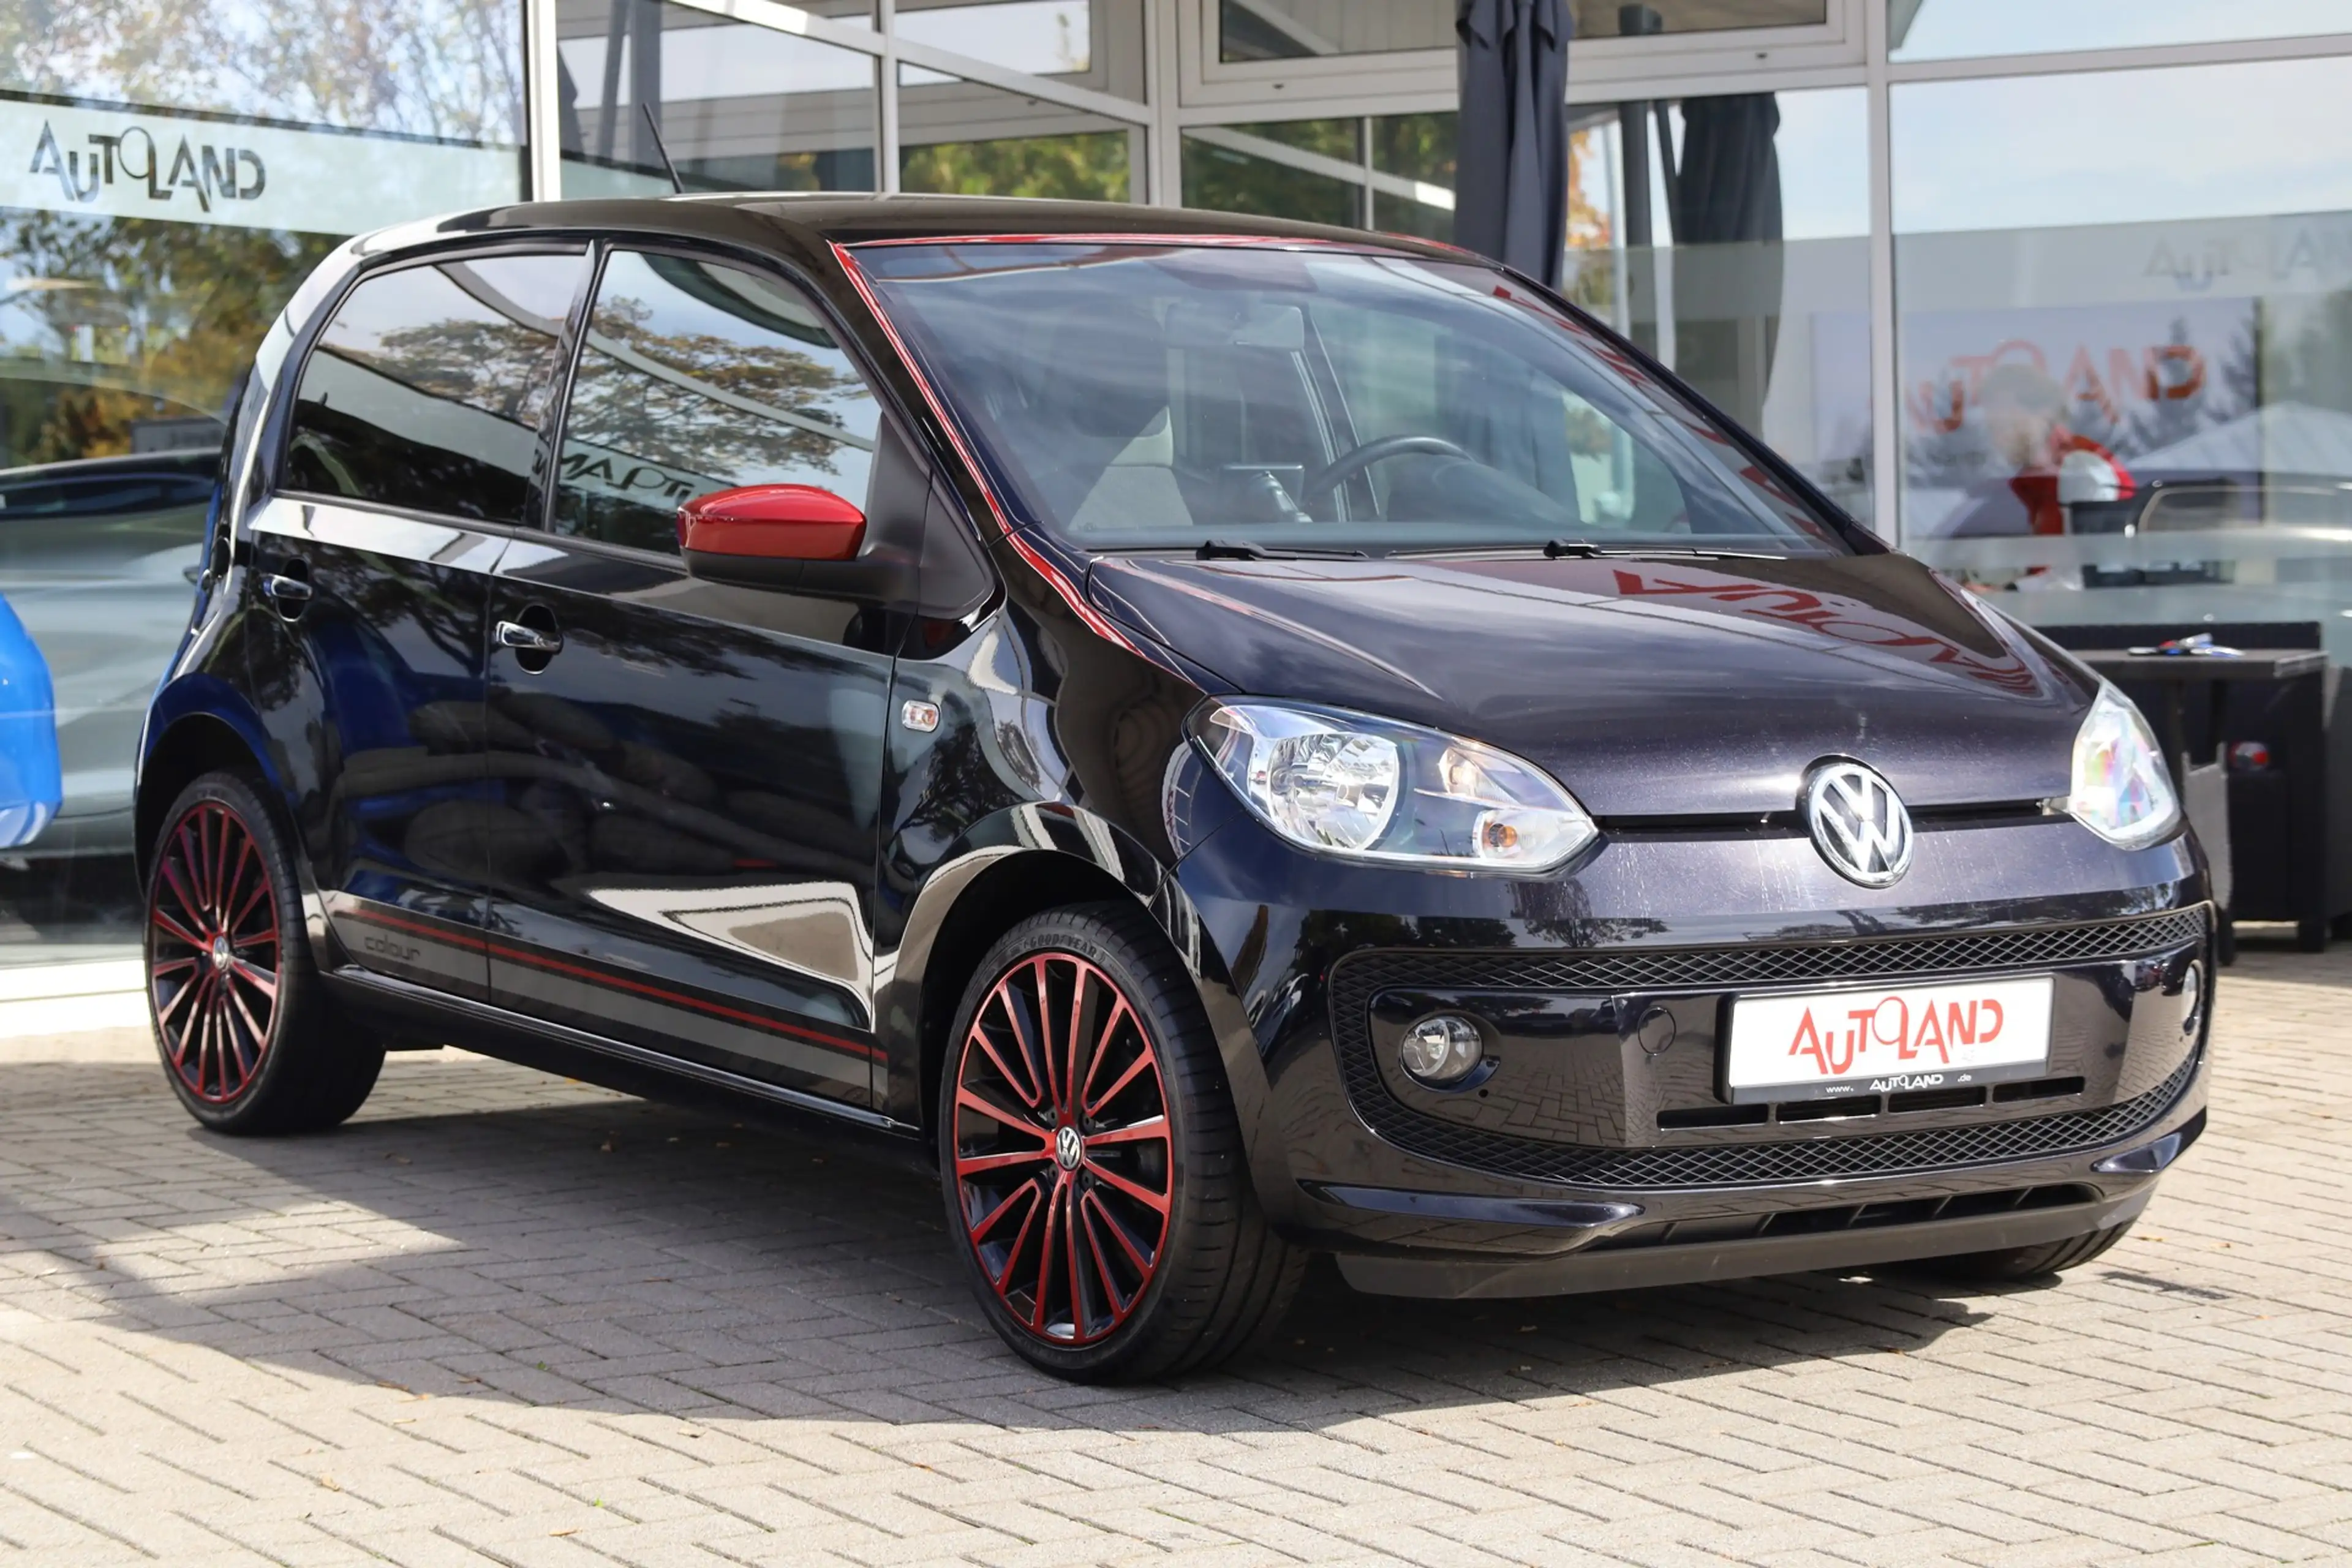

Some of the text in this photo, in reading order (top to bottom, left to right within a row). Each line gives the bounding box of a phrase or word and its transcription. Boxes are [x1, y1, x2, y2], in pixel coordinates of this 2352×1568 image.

[29, 118, 266, 213] AUTOLAND
[1811, 764, 1911, 884] VW
[364, 934, 420, 960] colour
[1788, 995, 2003, 1075] AUTOLAND
[1869, 1074, 1944, 1093] AUTOLAND
[1957, 1073, 1972, 1082] .de
[1056, 1127, 1080, 1169] VW
